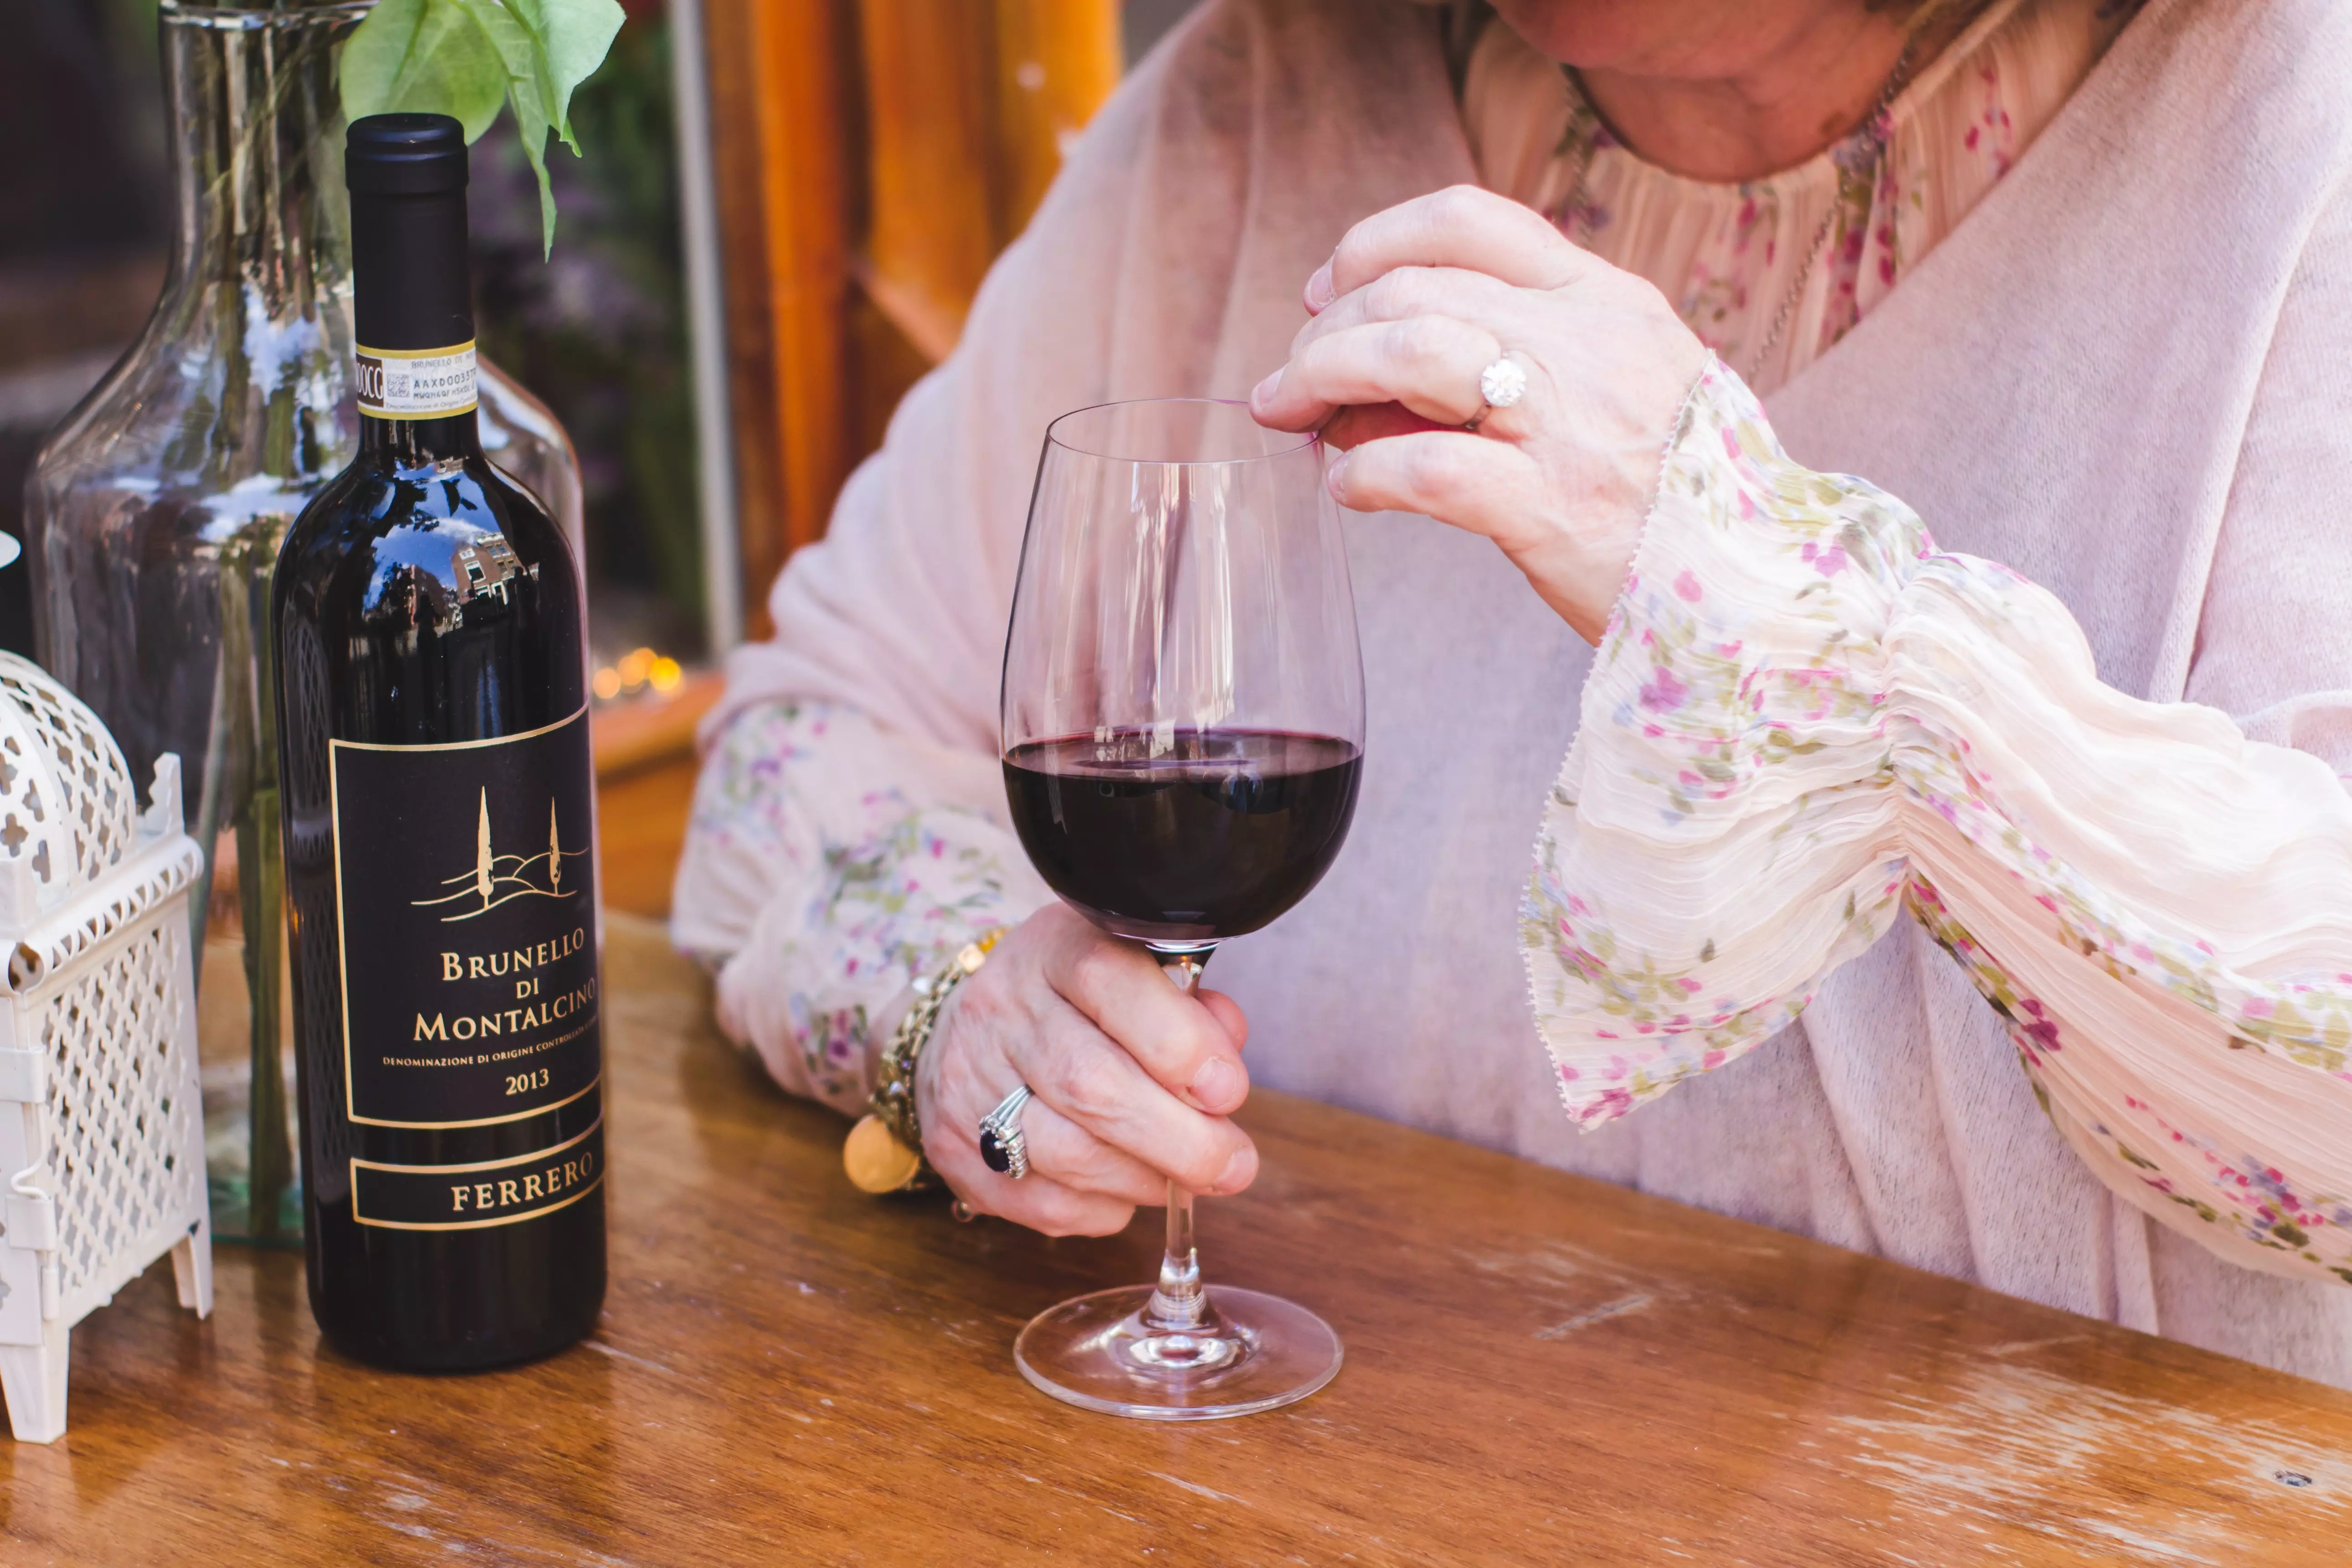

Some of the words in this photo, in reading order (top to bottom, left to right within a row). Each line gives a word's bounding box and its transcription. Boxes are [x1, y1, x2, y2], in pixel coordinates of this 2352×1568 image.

[441, 927, 584, 981] BRUNELLO
[516, 978, 539, 999] DI
[413, 977, 595, 1041] MONTALCINO
[383, 1056, 473, 1066] DENOMINAZIONE
[478, 1054, 488, 1064] DI
[493, 1046, 533, 1061] ORIGINE
[506, 1068, 549, 1095] 2013
[451, 1152, 592, 1211] FERRERO
